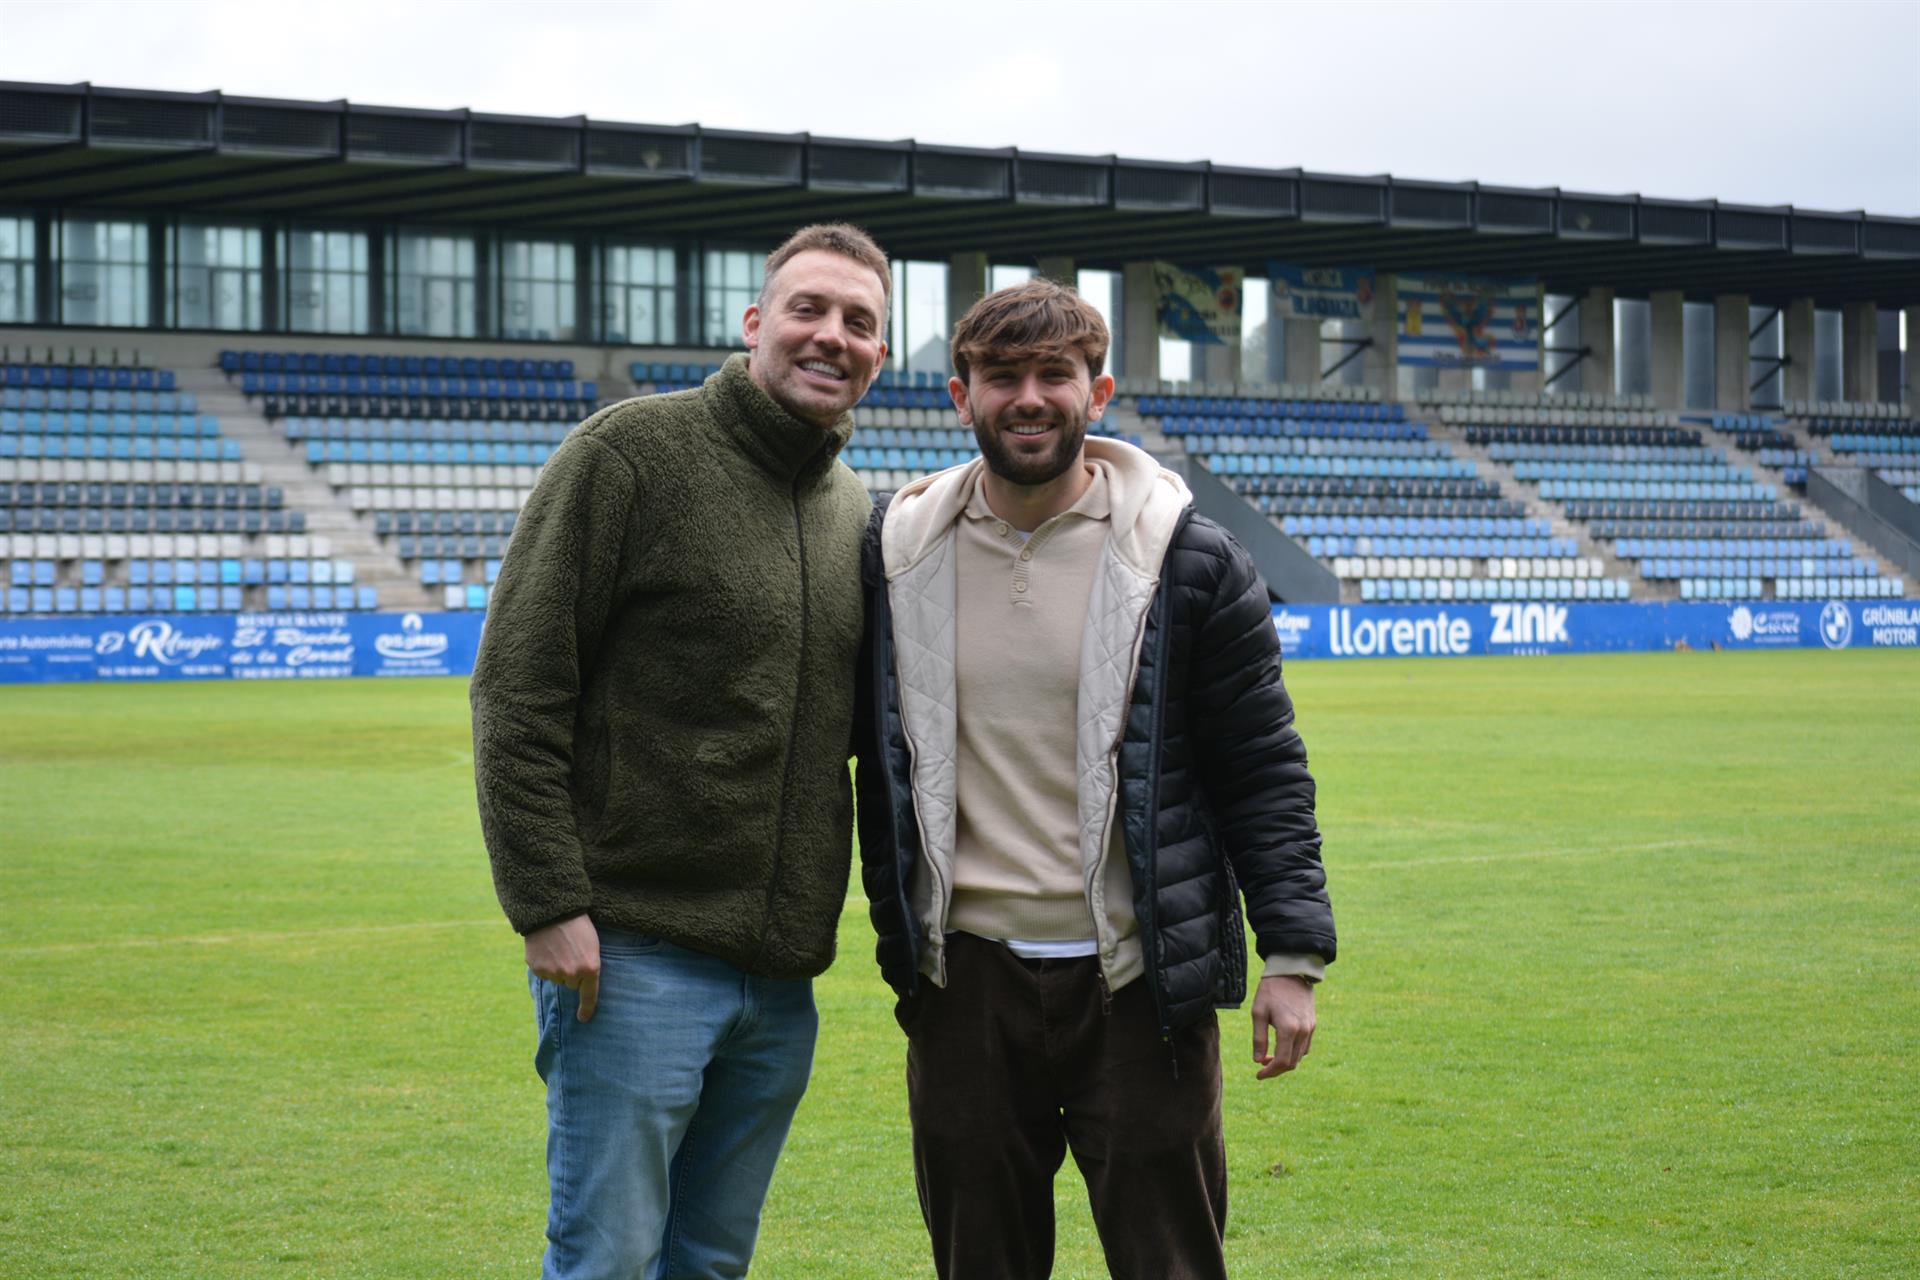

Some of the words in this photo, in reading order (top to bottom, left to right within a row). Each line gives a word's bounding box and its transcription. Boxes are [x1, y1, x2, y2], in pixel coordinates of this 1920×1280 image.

[1329, 608, 1472, 655] llorente
[1489, 602, 1569, 643] ZINK
[1872, 627, 1917, 646] MOTOR
